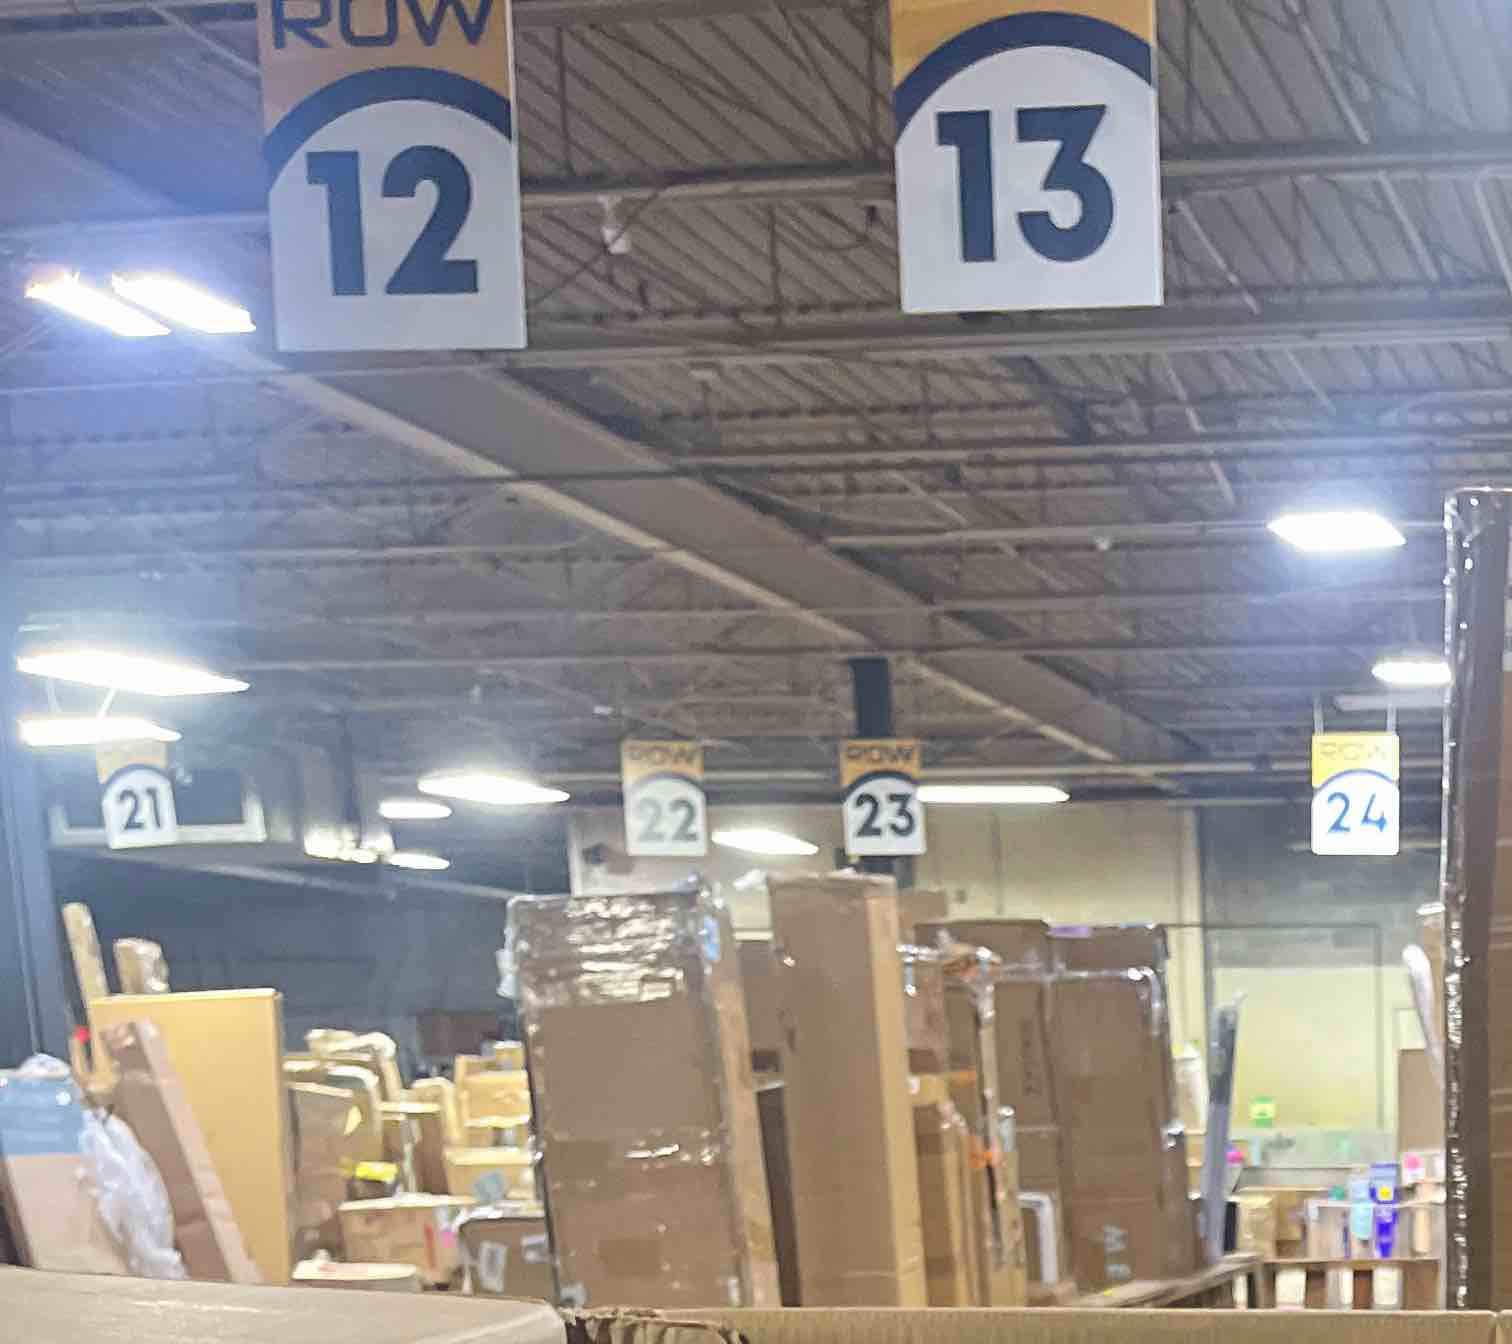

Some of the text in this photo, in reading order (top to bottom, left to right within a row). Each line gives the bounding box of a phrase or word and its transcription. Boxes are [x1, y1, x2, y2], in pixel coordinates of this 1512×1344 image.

[273, 0, 492, 49] ROW
[937, 105, 1114, 262] 13
[306, 145, 478, 296] 12
[118, 787, 161, 831] 21
[636, 797, 699, 842] 22
[856, 793, 915, 837] 23
[1327, 791, 1388, 834] 24
